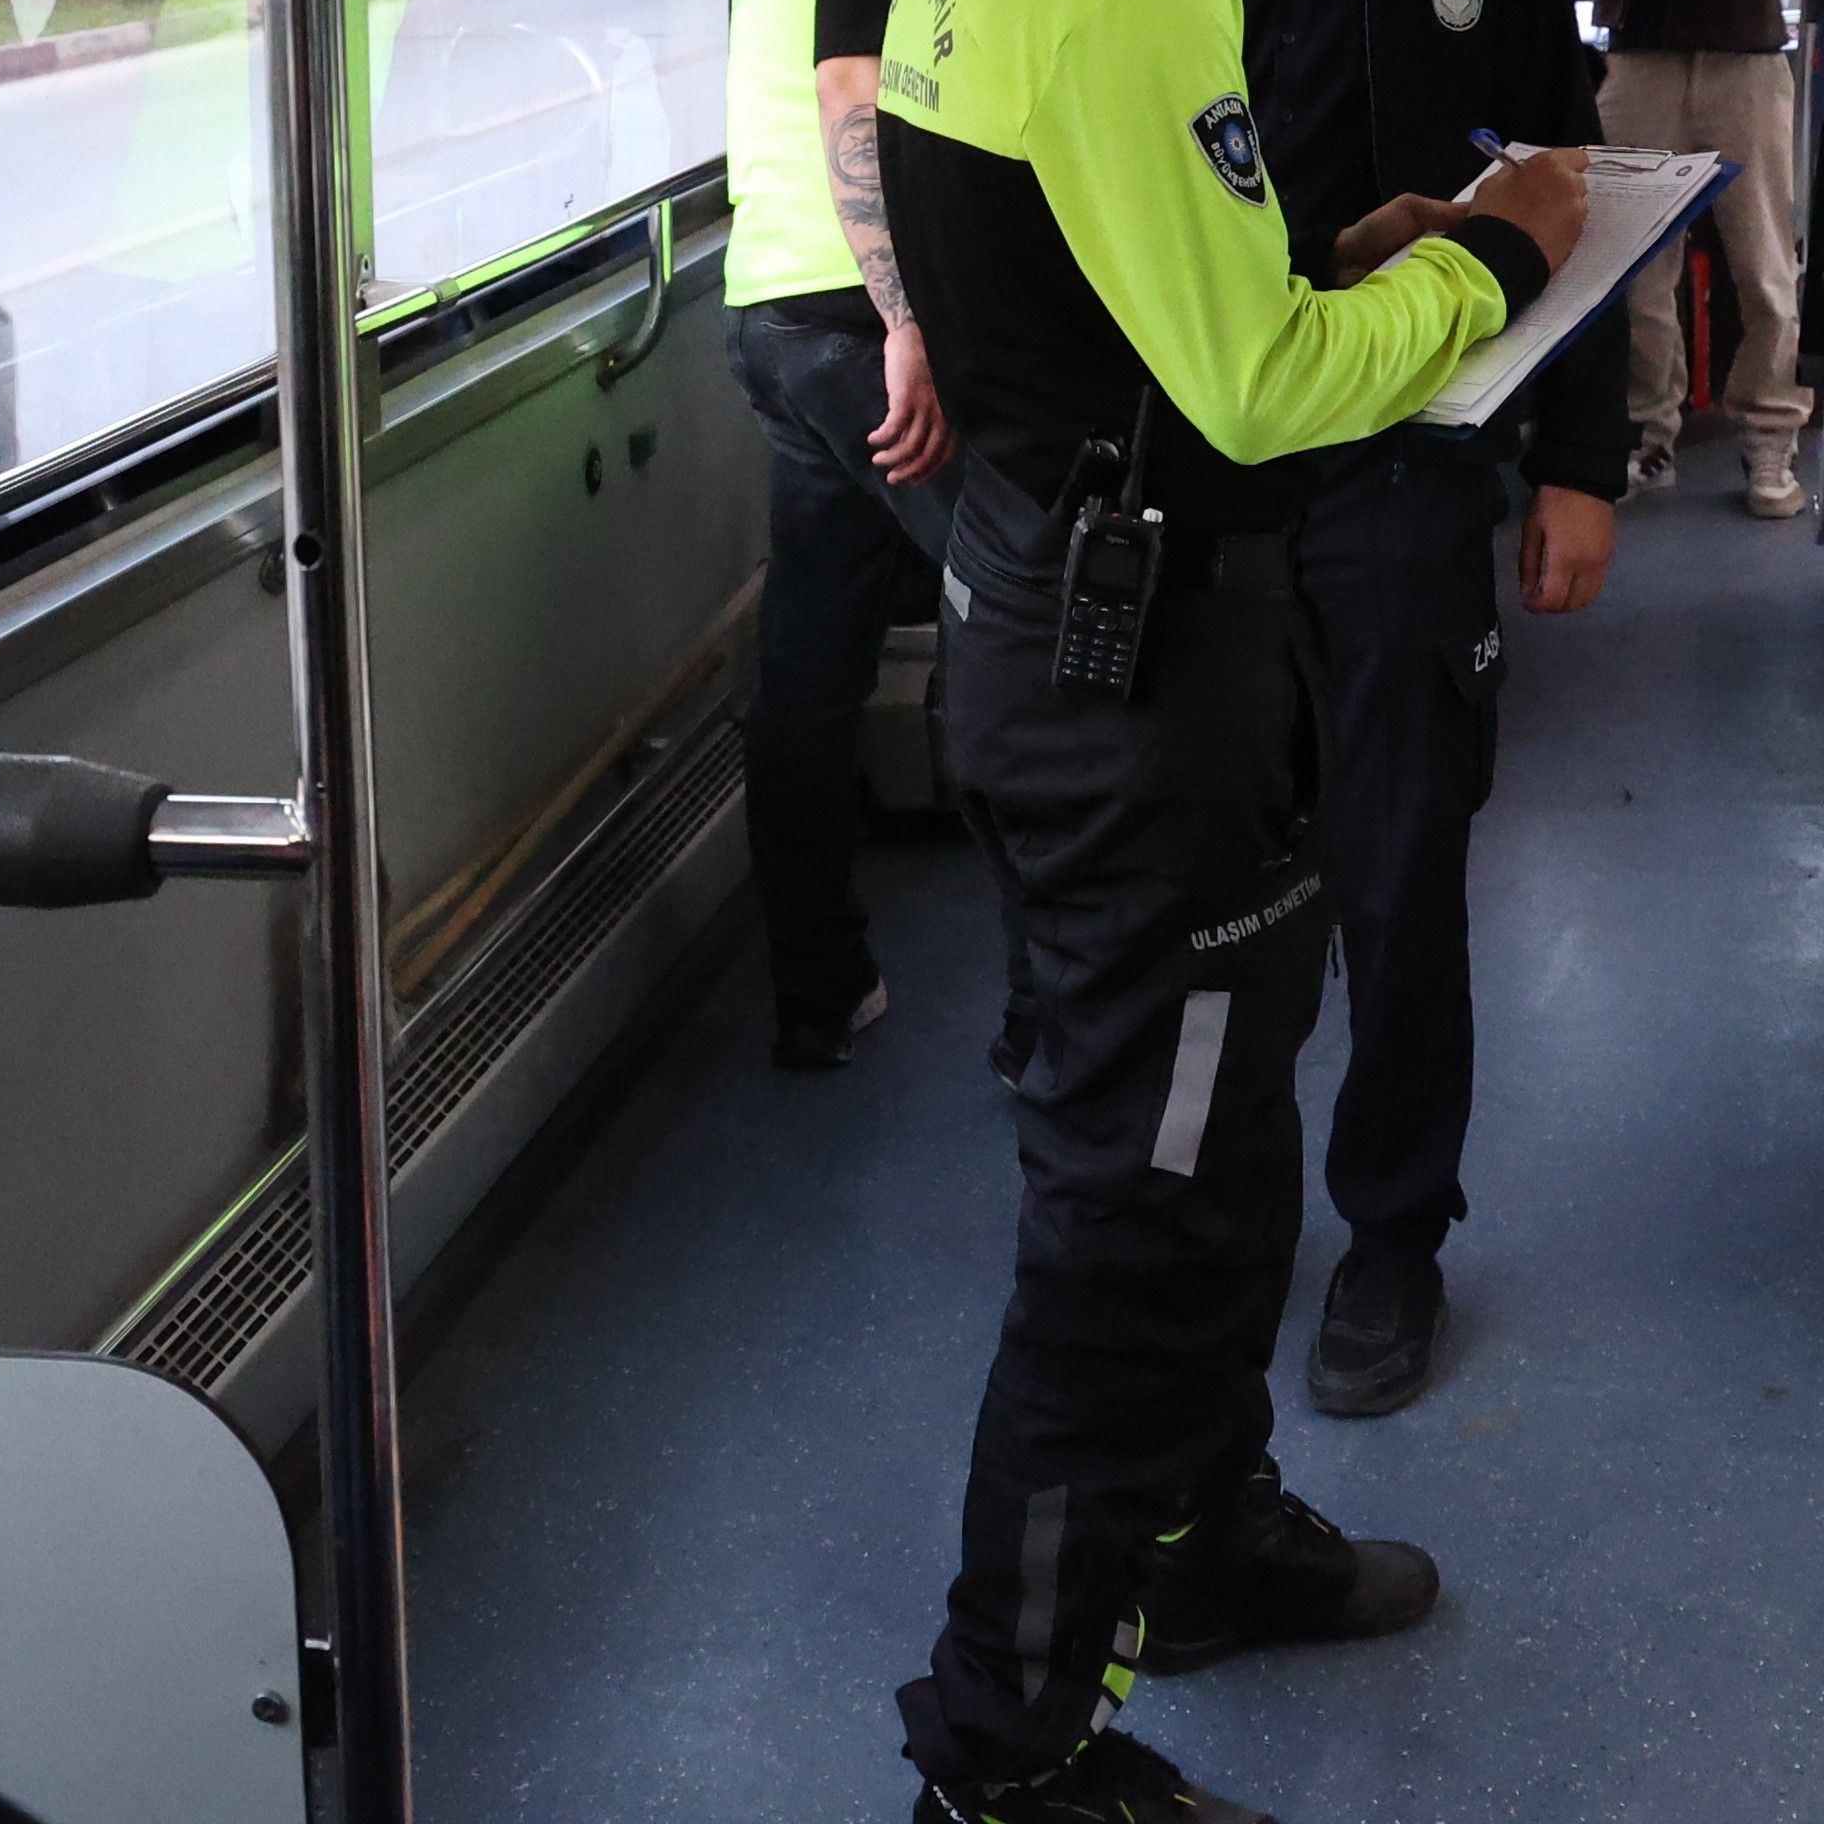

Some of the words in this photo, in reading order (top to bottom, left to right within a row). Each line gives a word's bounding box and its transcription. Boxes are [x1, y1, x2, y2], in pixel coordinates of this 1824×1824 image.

[900, 65, 940, 113] DENETİM
[1190, 913, 1262, 951] ULAŞIM
[1263, 872, 1323, 927] DENETİM
